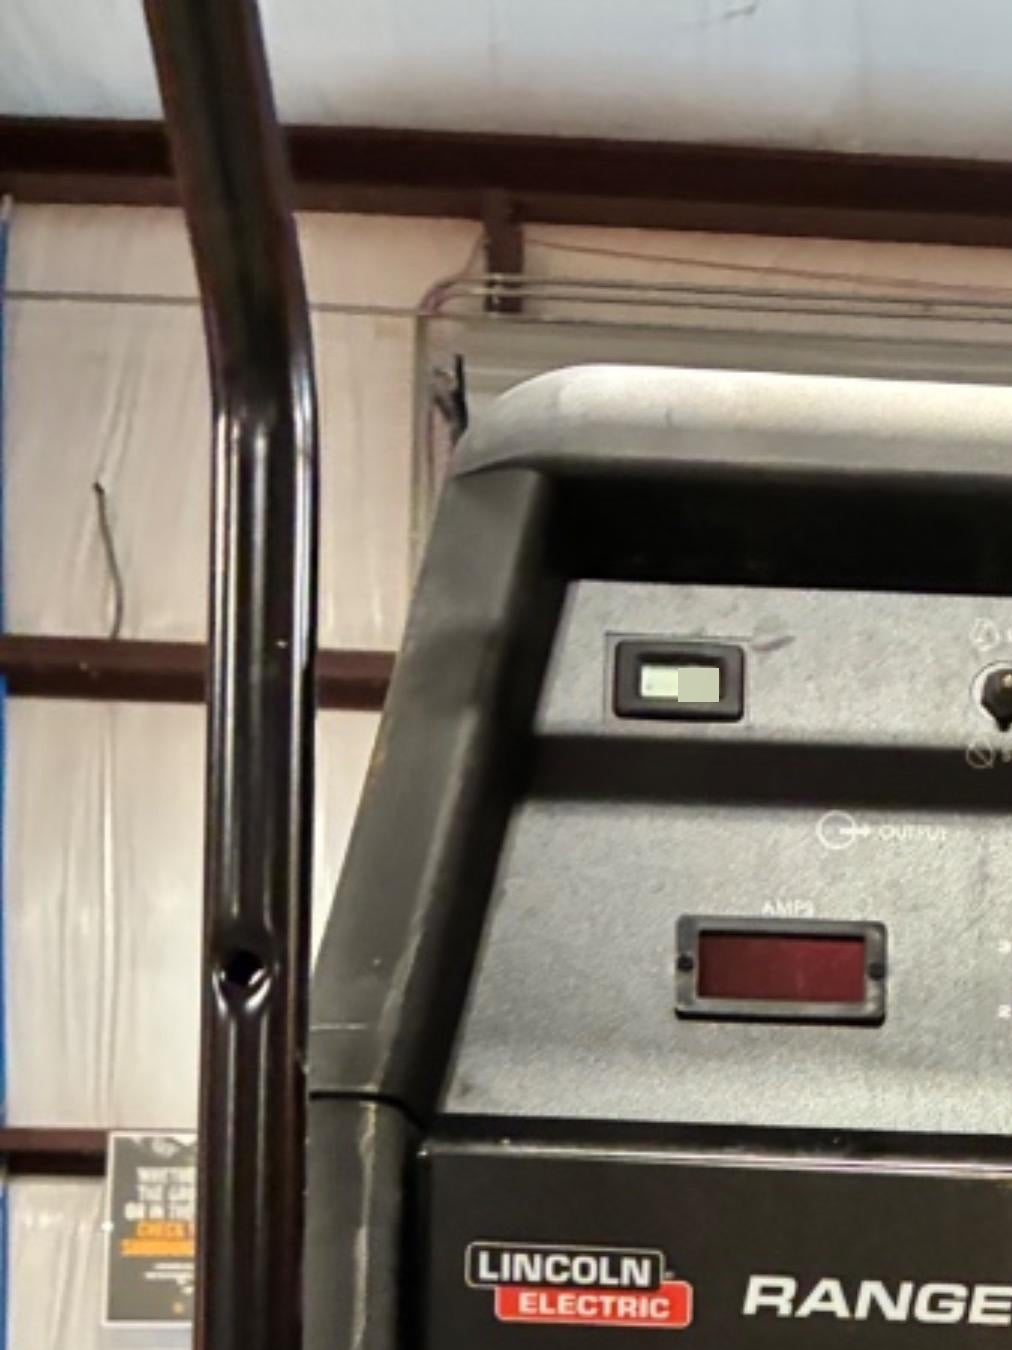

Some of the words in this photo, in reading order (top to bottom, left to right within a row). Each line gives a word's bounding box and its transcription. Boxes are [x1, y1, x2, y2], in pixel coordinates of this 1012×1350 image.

[877, 825, 948, 842] OUTPUT
[761, 900, 814, 917] AMPS
[478, 1251, 652, 1287] LINCOLN
[518, 1291, 671, 1321] ELECTRIC
